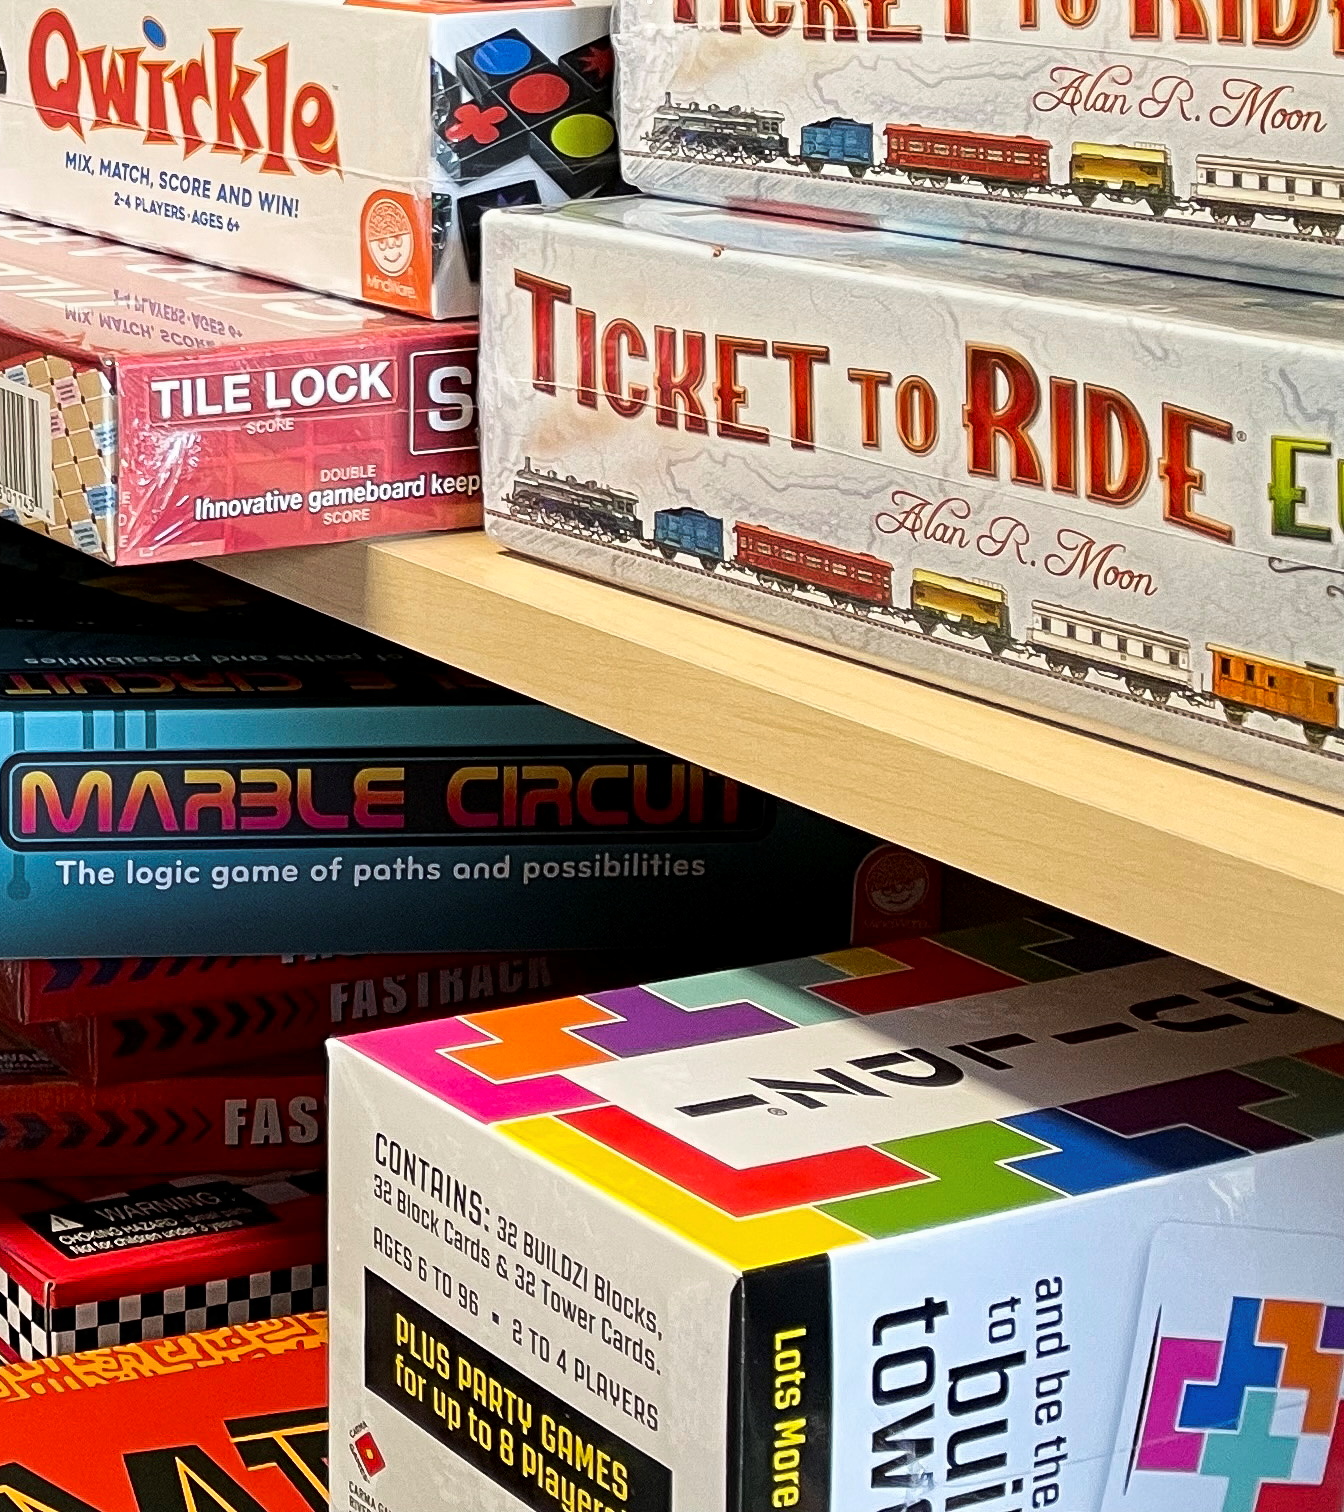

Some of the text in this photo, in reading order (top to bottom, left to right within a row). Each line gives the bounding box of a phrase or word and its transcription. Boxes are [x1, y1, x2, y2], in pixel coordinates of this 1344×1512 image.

[27, 6, 345, 181] Qwirkle
[1033, 65, 1329, 136] Alan R. Moon
[64, 150, 300, 219] MIX, MATCH, SCORE AND WIN!
[150, 360, 393, 420] TILE LOCK
[514, 265, 830, 451] TICKET
[848, 366, 939, 456] TO
[963, 340, 1237, 547] RIDE
[245, 417, 295, 435] SCORE
[194, 488, 303, 522] Innovative
[308, 475, 427, 513] gameboard
[319, 463, 377, 483] DOUBLE
[322, 506, 371, 526] SCORE
[874, 489, 1162, 598] Alan R. Moon
[19, 767, 406, 836] MARBLE
[55, 849, 707, 890] The logic game of paths and possibilities
[329, 954, 554, 1024] FASTRACK
[373, 1131, 665, 1342] CONTAINS: 32 BUILDZI Blocks,
[372, 1174, 663, 1377] 32 Block Cards & 32 Tower Cards.
[372, 1228, 661, 1433] AGES 6 TO 96 2 TO 4 PLAYERS
[394, 1311, 630, 1503] PLUS PARTY GAMES
[770, 1326, 807, 1508] Lots More
[1033, 1276, 1071, 1511] and be the
